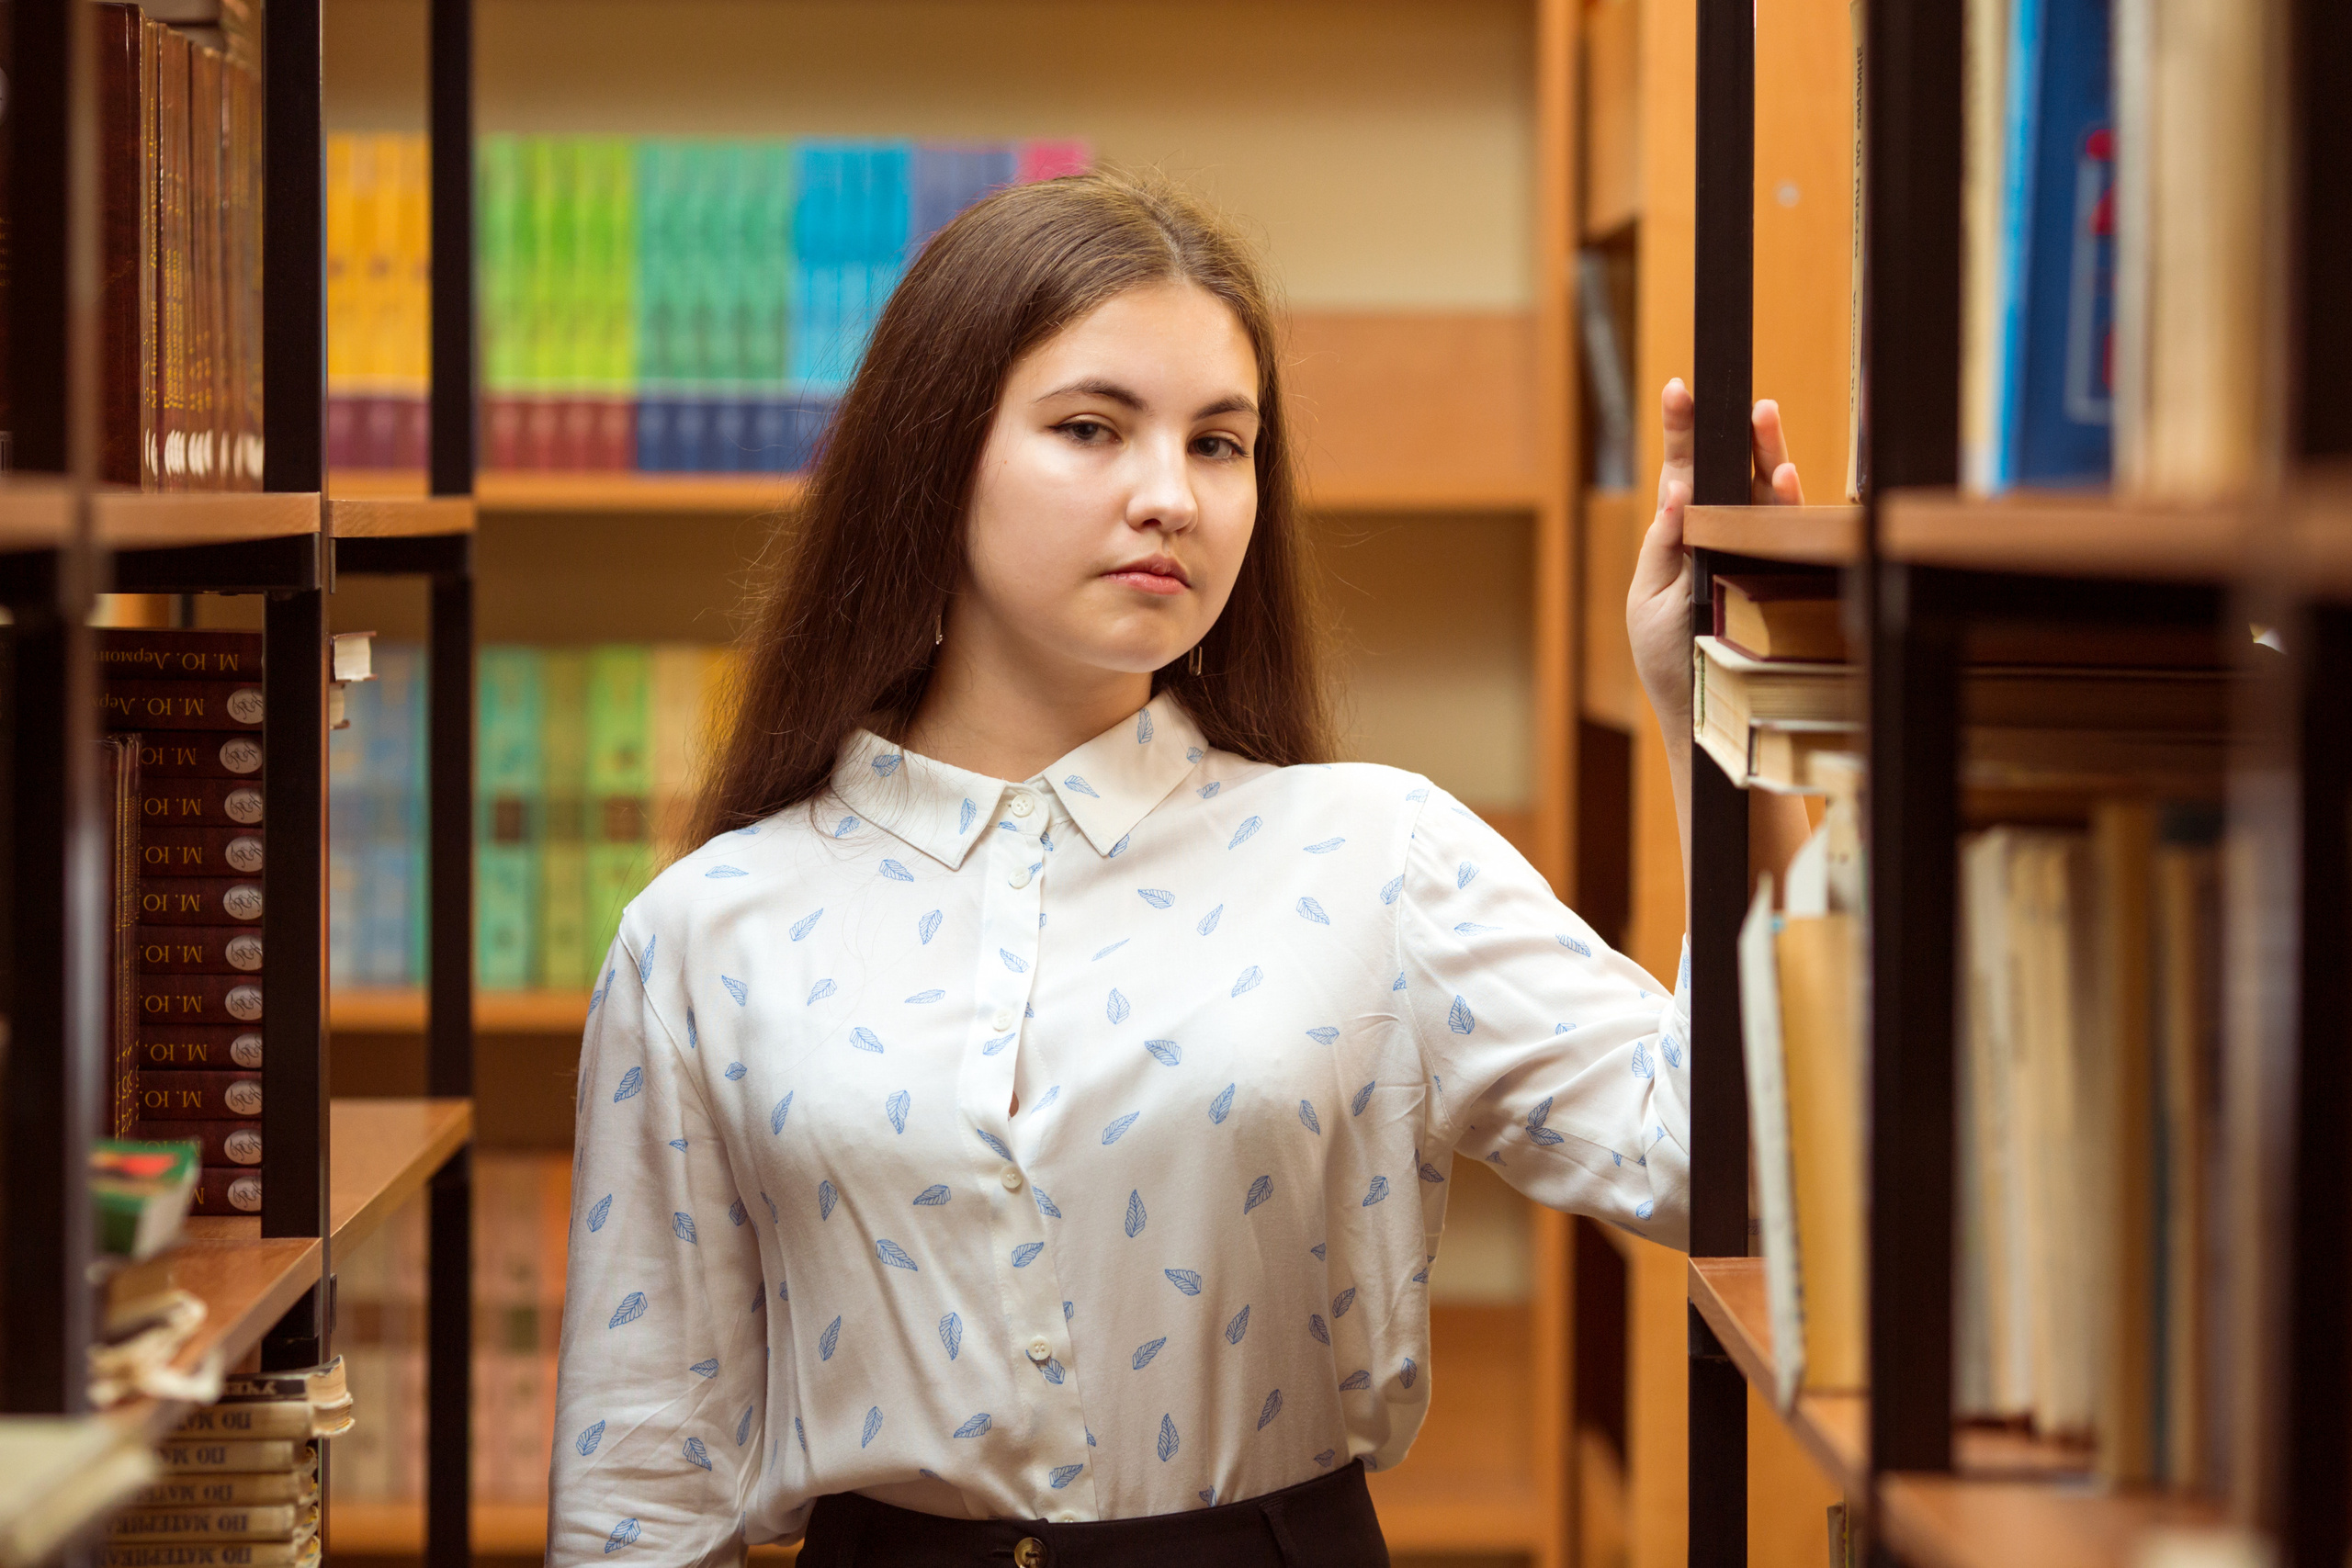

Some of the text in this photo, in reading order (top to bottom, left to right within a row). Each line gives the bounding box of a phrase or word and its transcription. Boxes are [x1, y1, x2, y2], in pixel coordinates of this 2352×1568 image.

[176, 652, 206, 671] Ю.
[213, 653, 239, 671] М.
[142, 697, 172, 716] Ю.
[178, 698, 204, 716] М.
[171, 747, 197, 765] М.
[175, 797, 201, 816] М.
[176, 846, 202, 864] М.
[175, 894, 200, 912] М.
[176, 945, 202, 964] М.
[176, 995, 202, 1013] М.
[144, 1043, 208, 1062] М. Ю.
[176, 1090, 202, 1109] М.
[222, 1412, 252, 1430] ПО
[197, 1446, 226, 1465] ПО
[204, 1484, 233, 1502] ПО
[218, 1515, 248, 1533] ПО
[222, 1548, 252, 1565] ПО
